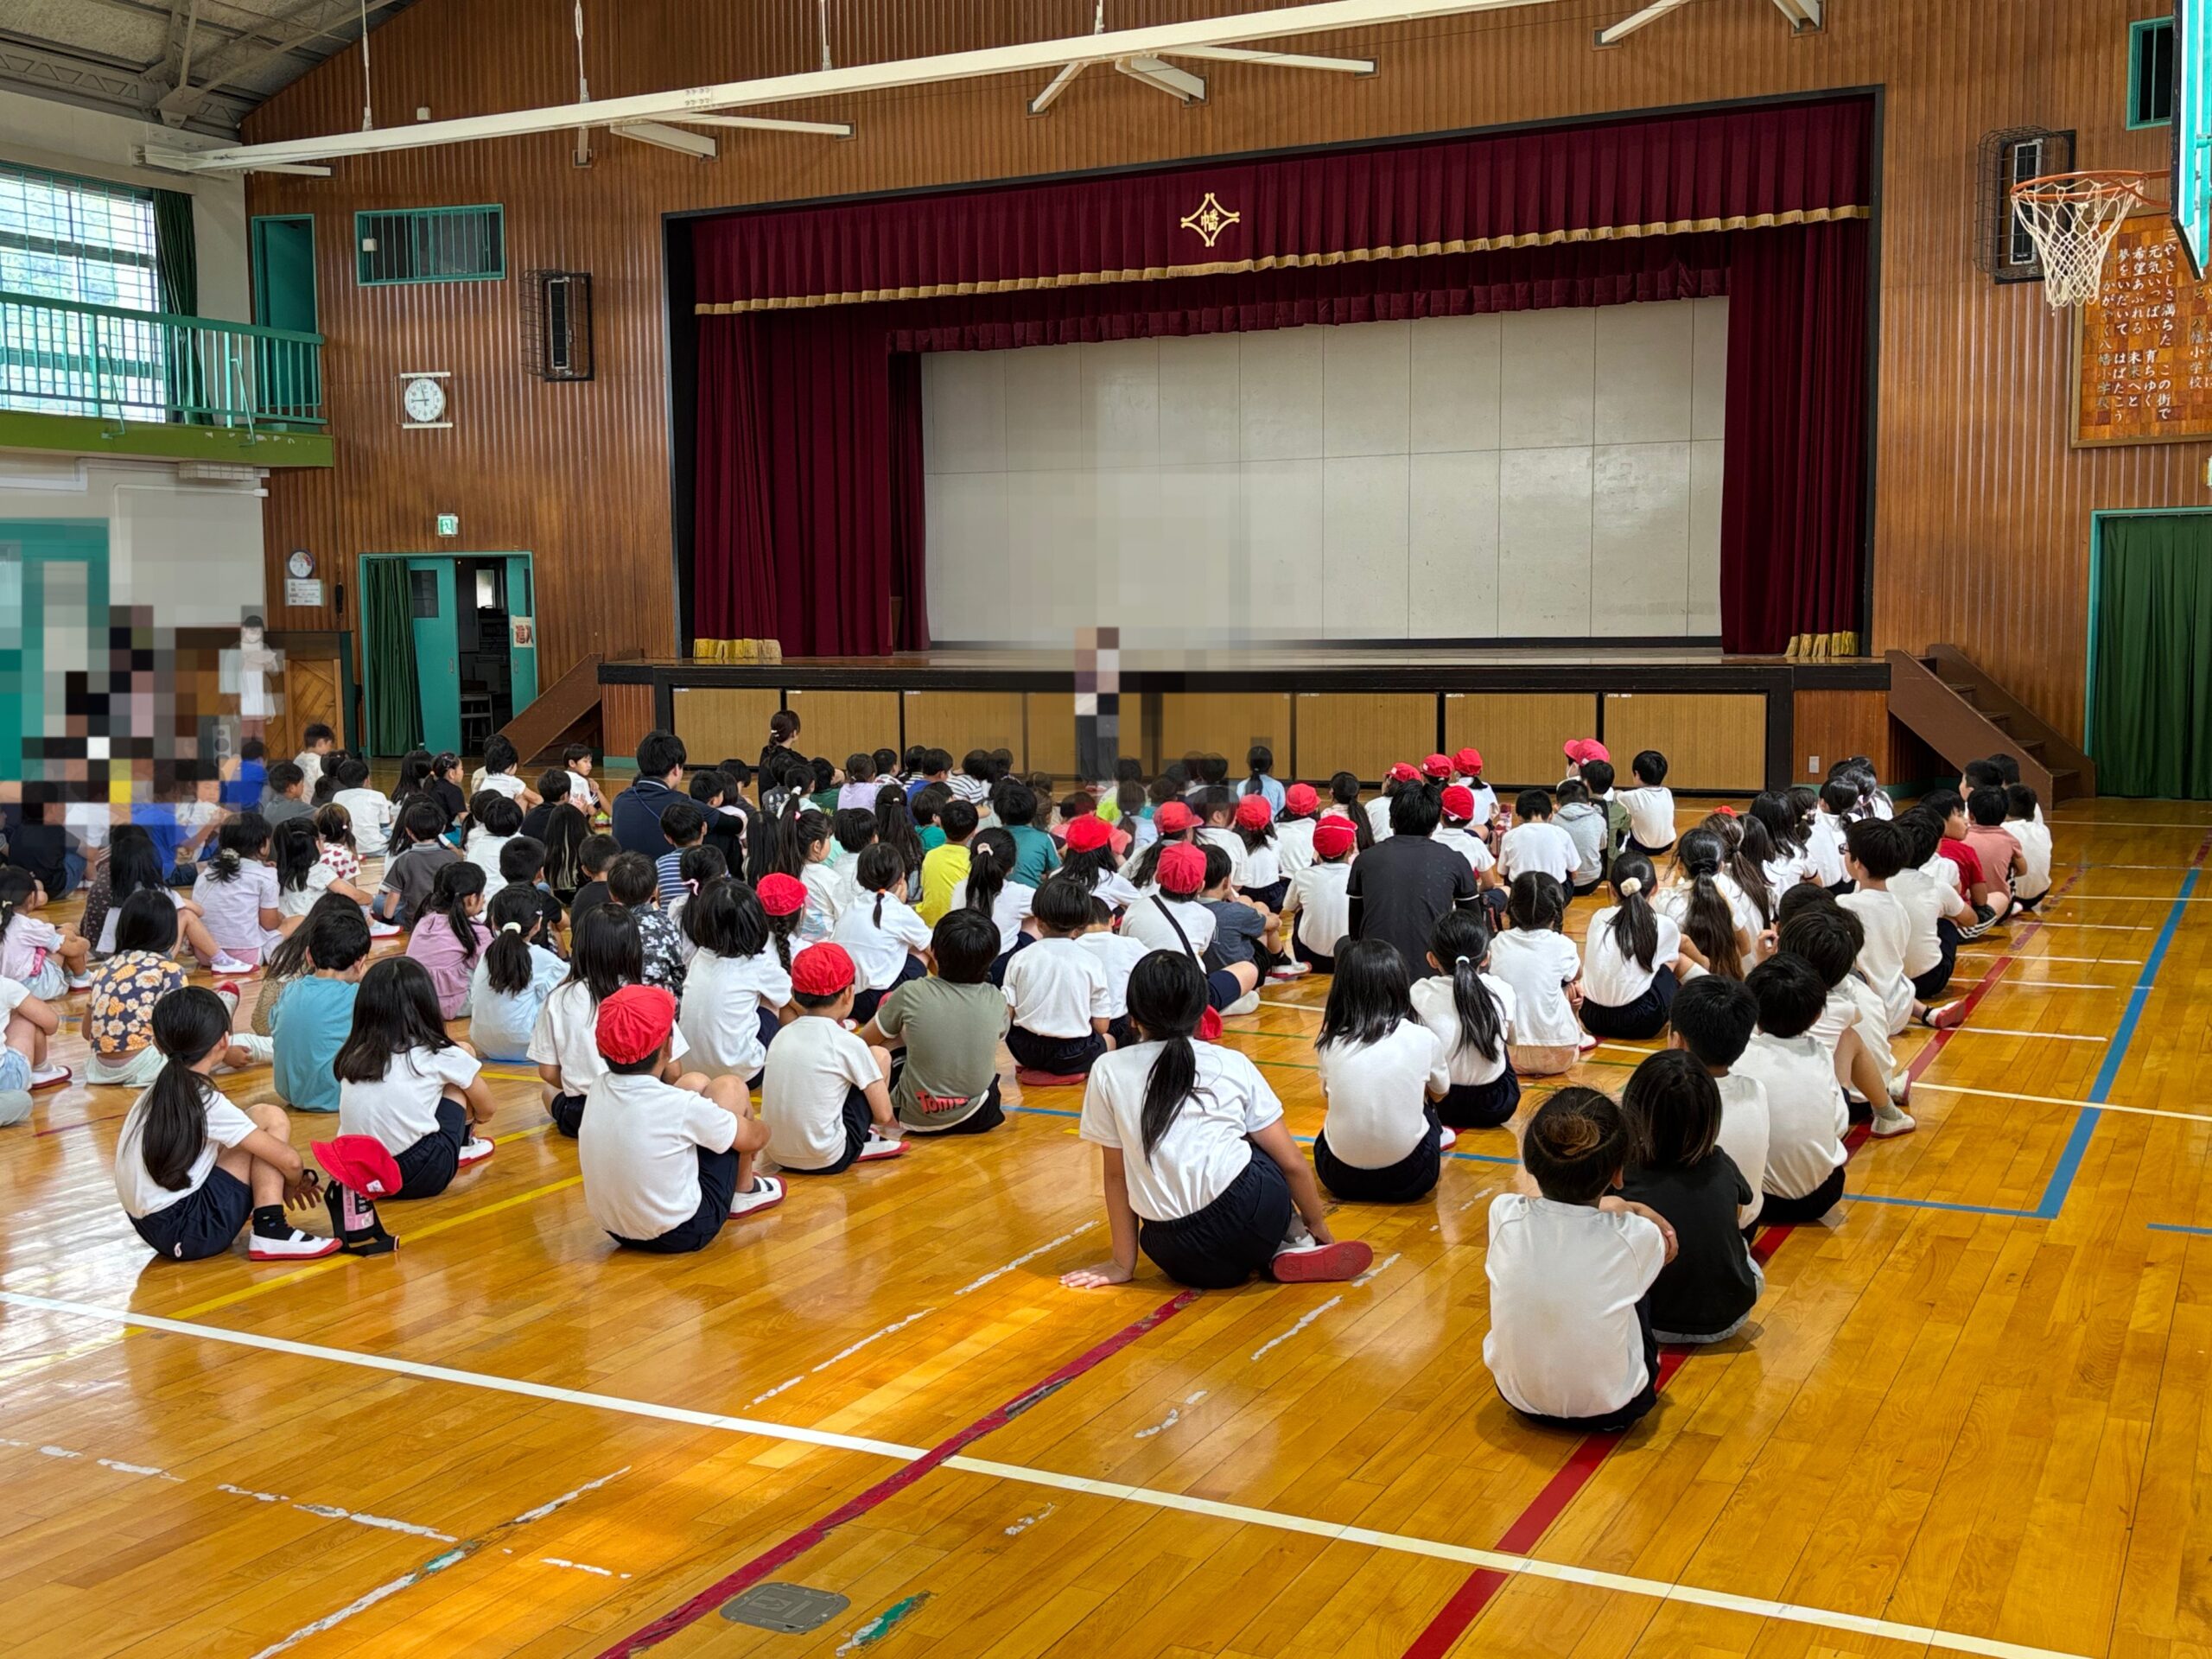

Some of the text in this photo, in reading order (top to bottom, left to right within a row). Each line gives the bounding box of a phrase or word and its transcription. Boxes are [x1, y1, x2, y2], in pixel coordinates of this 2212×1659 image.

[1200, 208, 1219, 232] 幡
[2113, 248, 2131, 423] 夢をいだいて はばたこう
[2128, 246, 2147, 407] 希望あふれる 未来へと
[2189, 317, 2205, 389] 八幡小学校
[2144, 349, 2158, 408] 育ちゆく
[2157, 364, 2171, 420] この街で
